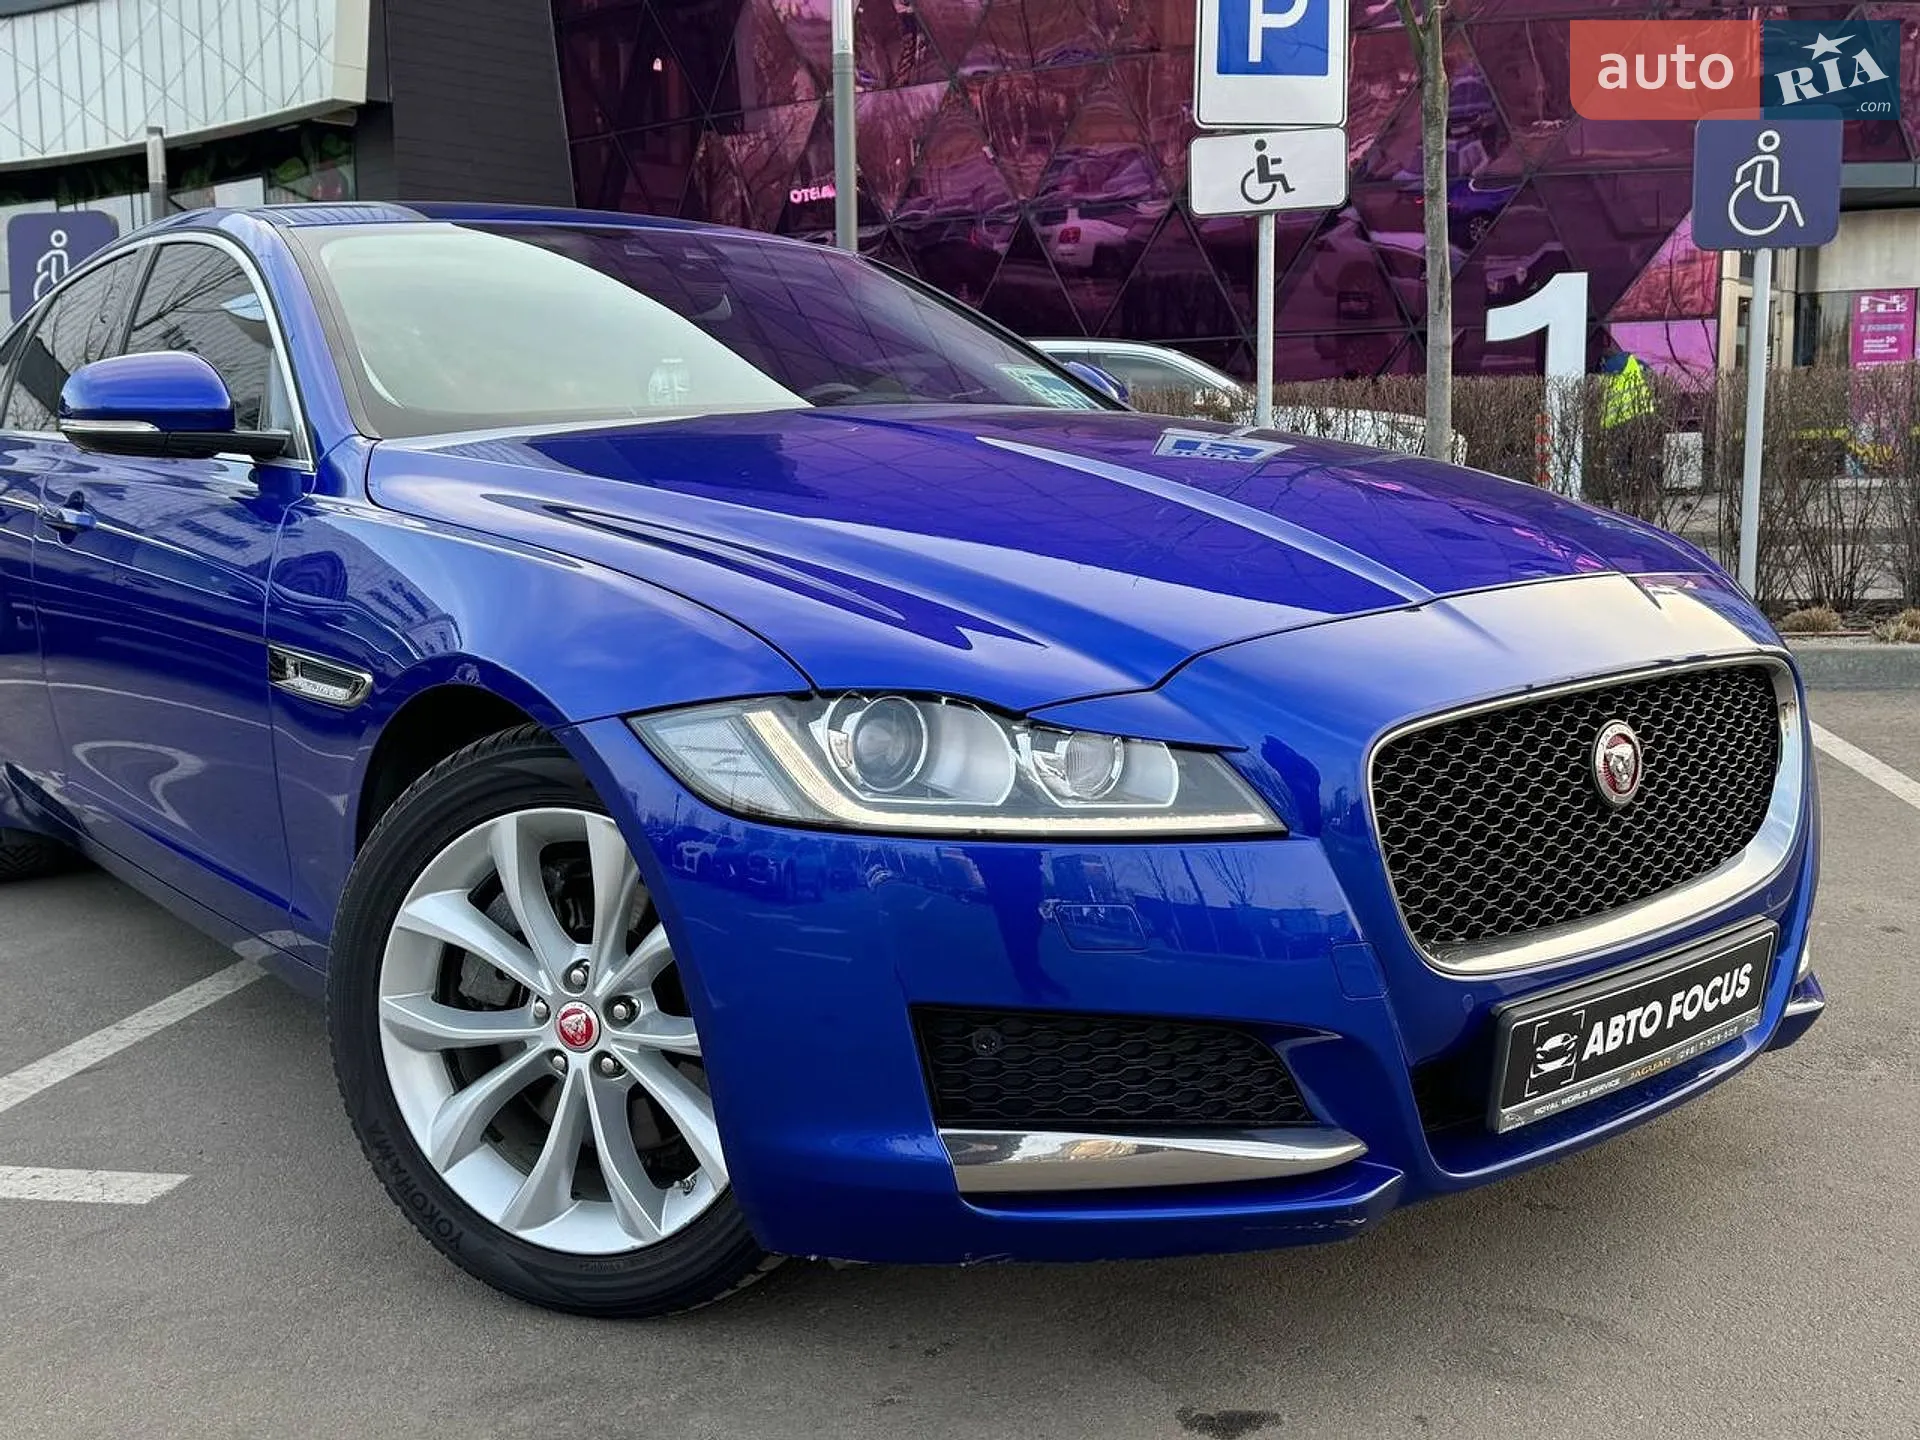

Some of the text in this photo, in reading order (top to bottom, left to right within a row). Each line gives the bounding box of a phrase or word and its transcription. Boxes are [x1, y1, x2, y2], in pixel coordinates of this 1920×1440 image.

[1248, 0, 1309, 63] P
[1581, 1003, 1662, 1061] АВТО
[1666, 962, 1753, 1030] FOCUS
[1629, 1057, 1671, 1080] JAGUAR
[367, 1120, 465, 1250] YOKOHAMA
